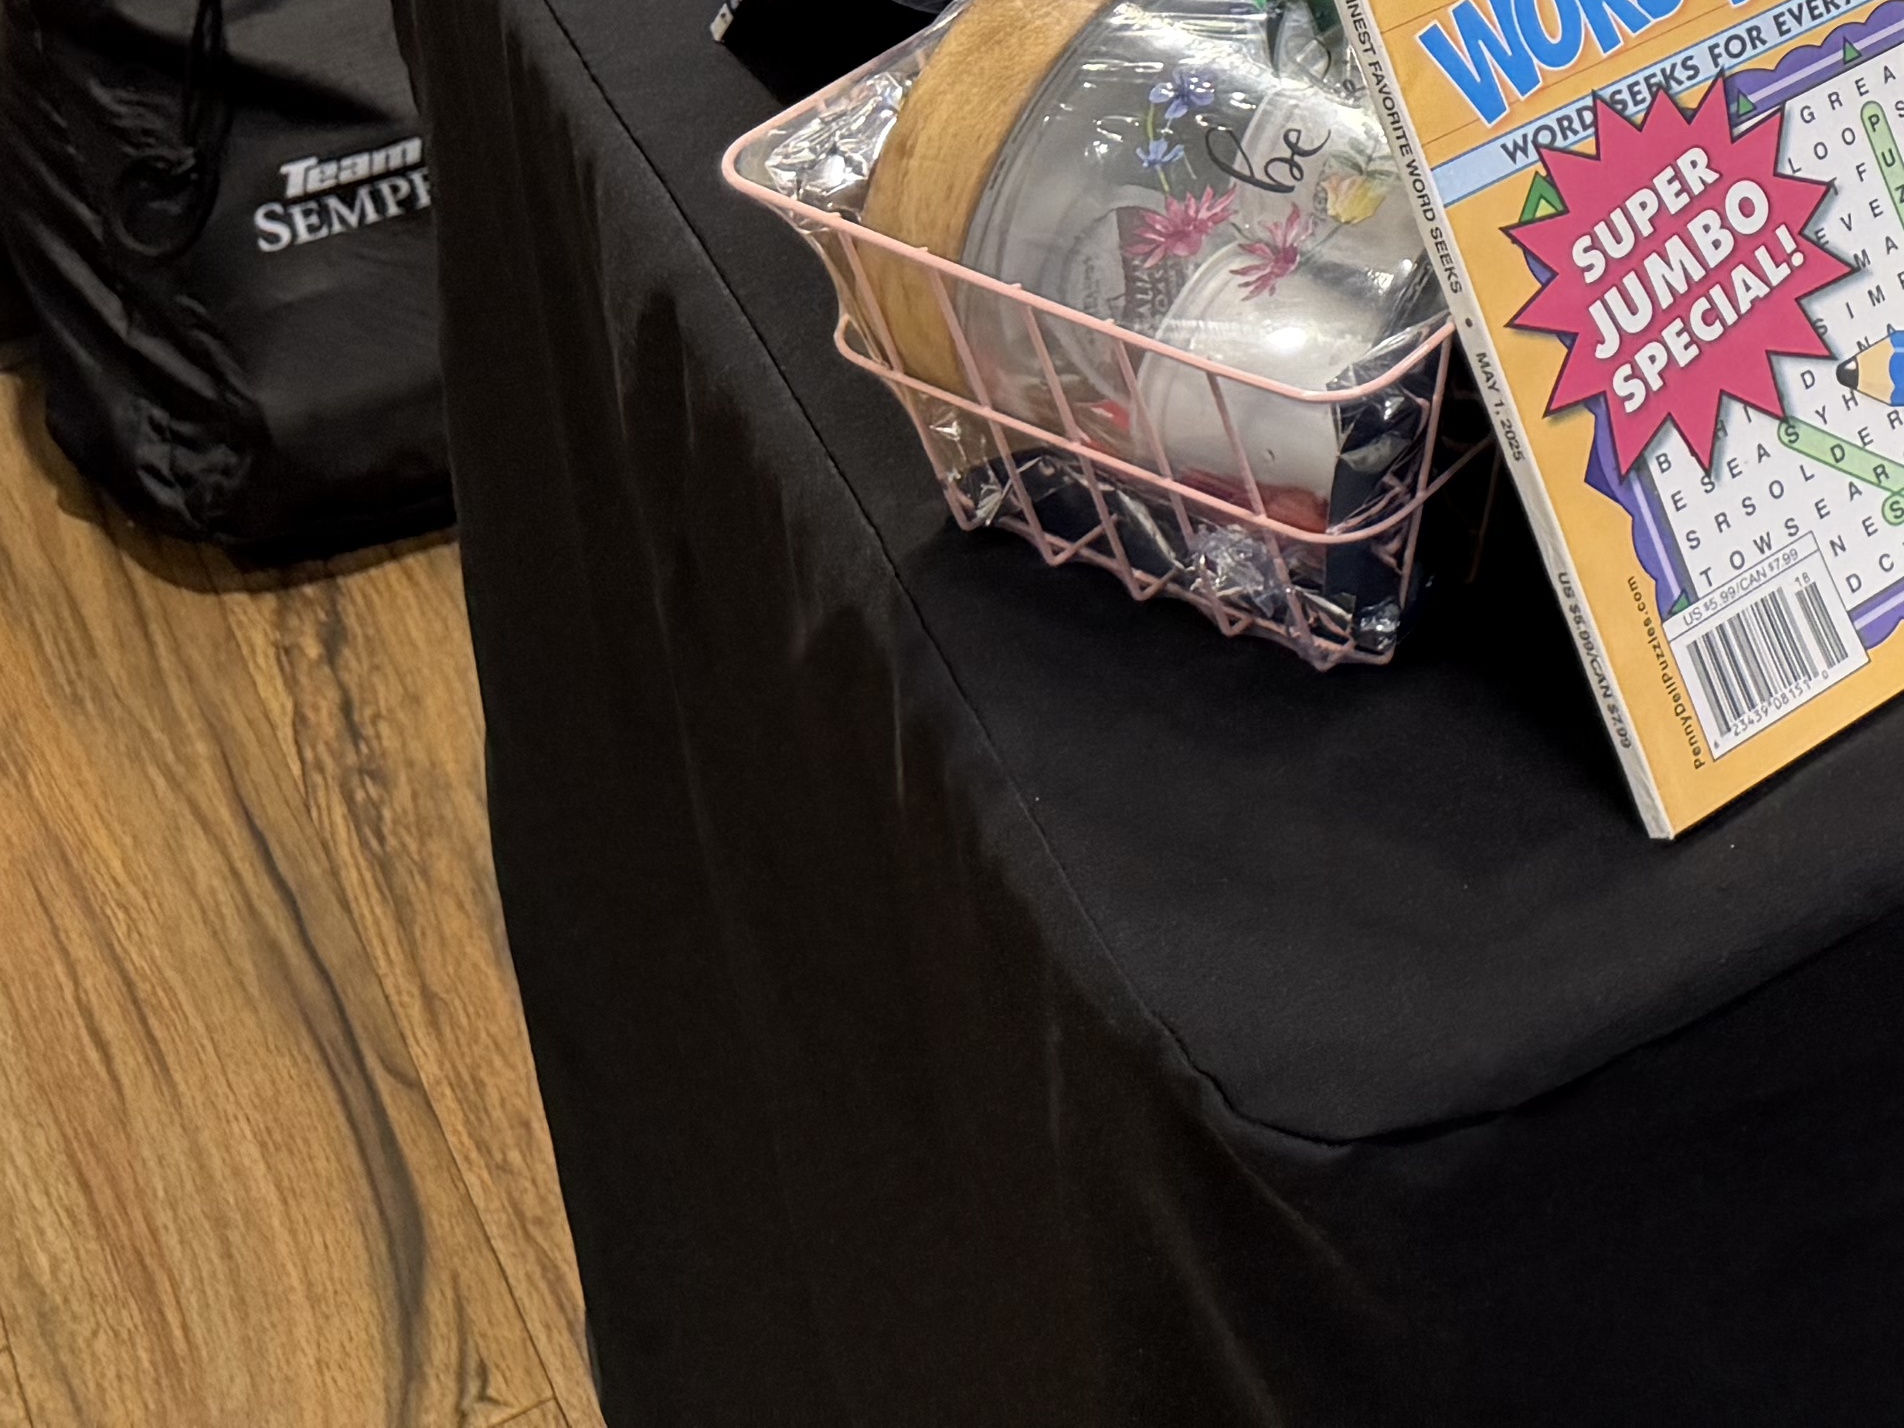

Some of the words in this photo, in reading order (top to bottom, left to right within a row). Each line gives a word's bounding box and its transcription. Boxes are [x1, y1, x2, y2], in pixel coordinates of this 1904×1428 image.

[1500, 104, 1597, 165] WORD
[1709, 25, 1768, 68] FOR
[279, 136, 422, 199] Team
[1368, 61, 1412, 157] FAVORITE
[1406, 159, 1436, 222] WORD
[1430, 227, 1463, 294] SEEKS
[1572, 146, 1722, 284] SUPER
[1588, 179, 1769, 360] JUMBO
[1612, 223, 1805, 414] SPECIAL!
[1476, 351, 1500, 393] MAY
[1500, 418, 1527, 462] 2025
[1683, 607, 1703, 627] US
[1767, 548, 1799, 573] $7.99
[1628, 575, 1706, 770] PennyDellPuzzles.com
